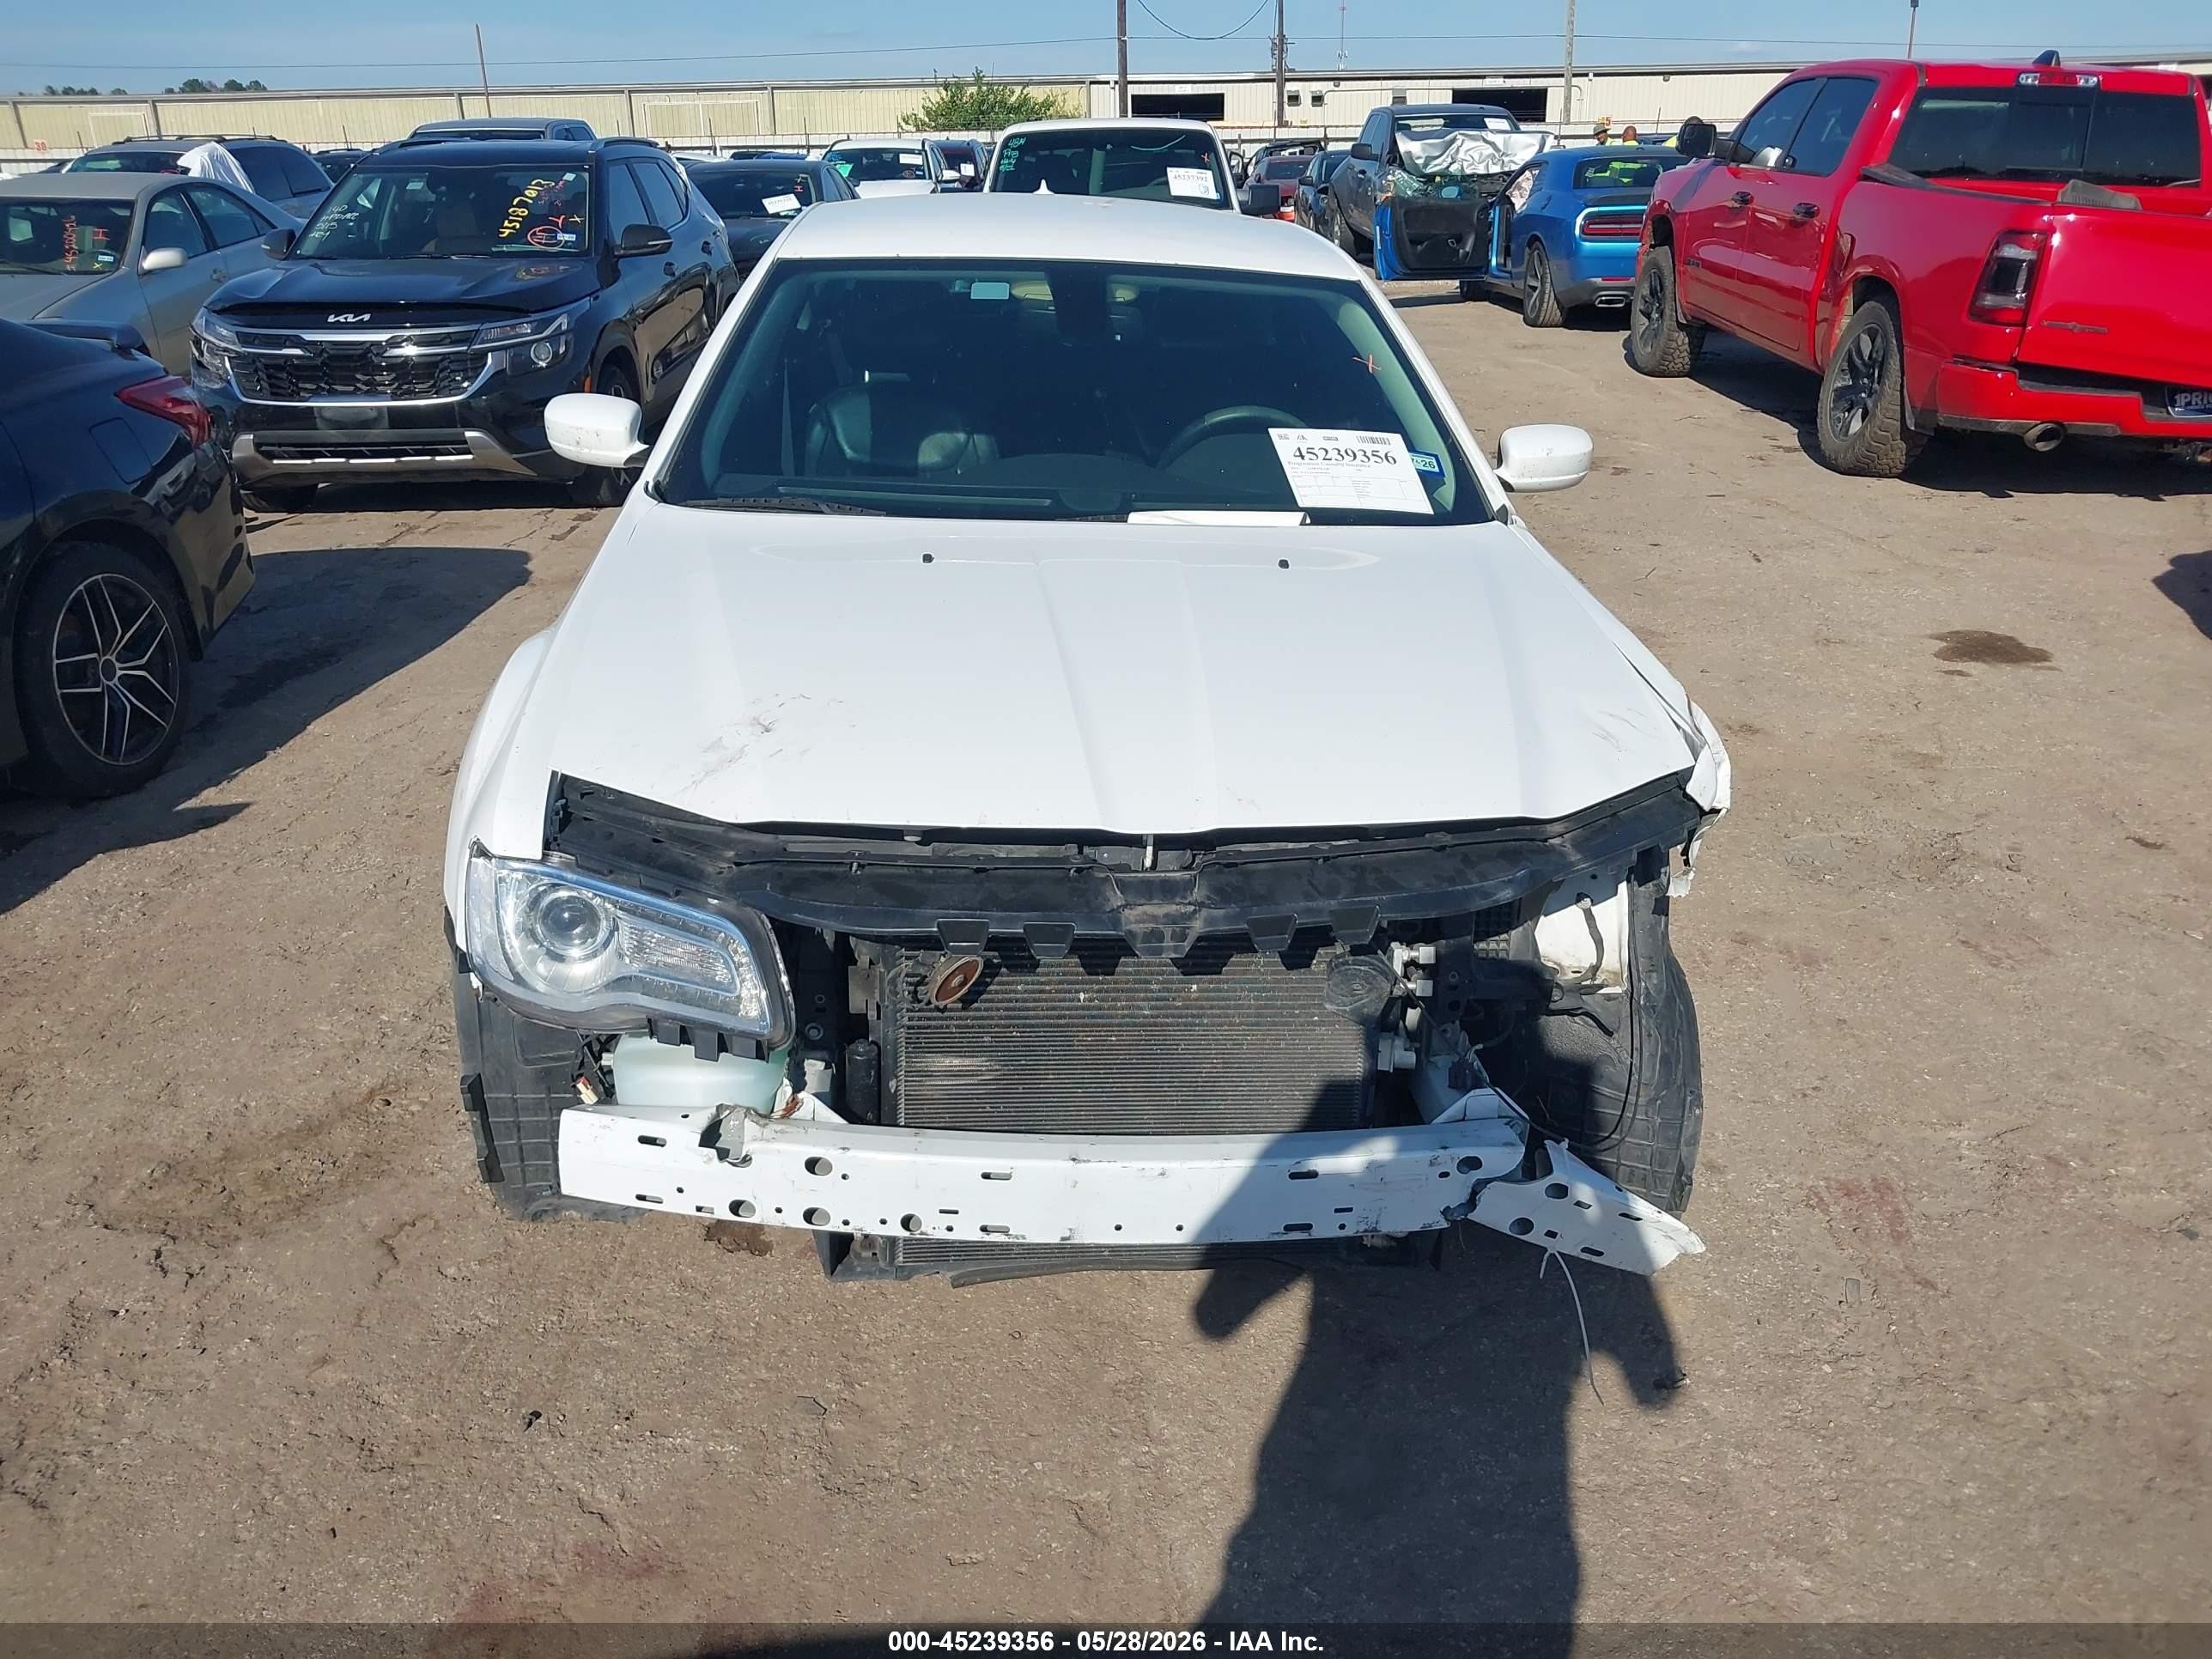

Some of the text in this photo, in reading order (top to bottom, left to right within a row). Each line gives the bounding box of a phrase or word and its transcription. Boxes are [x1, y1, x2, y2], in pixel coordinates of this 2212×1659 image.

[34, 142, 47, 152] 30
[327, 313, 372, 322] KIA
[2174, 391, 2212, 407] 1PRI
[1293, 446, 1398, 465] 45239356
[1420, 459, 1436, 469] 26
